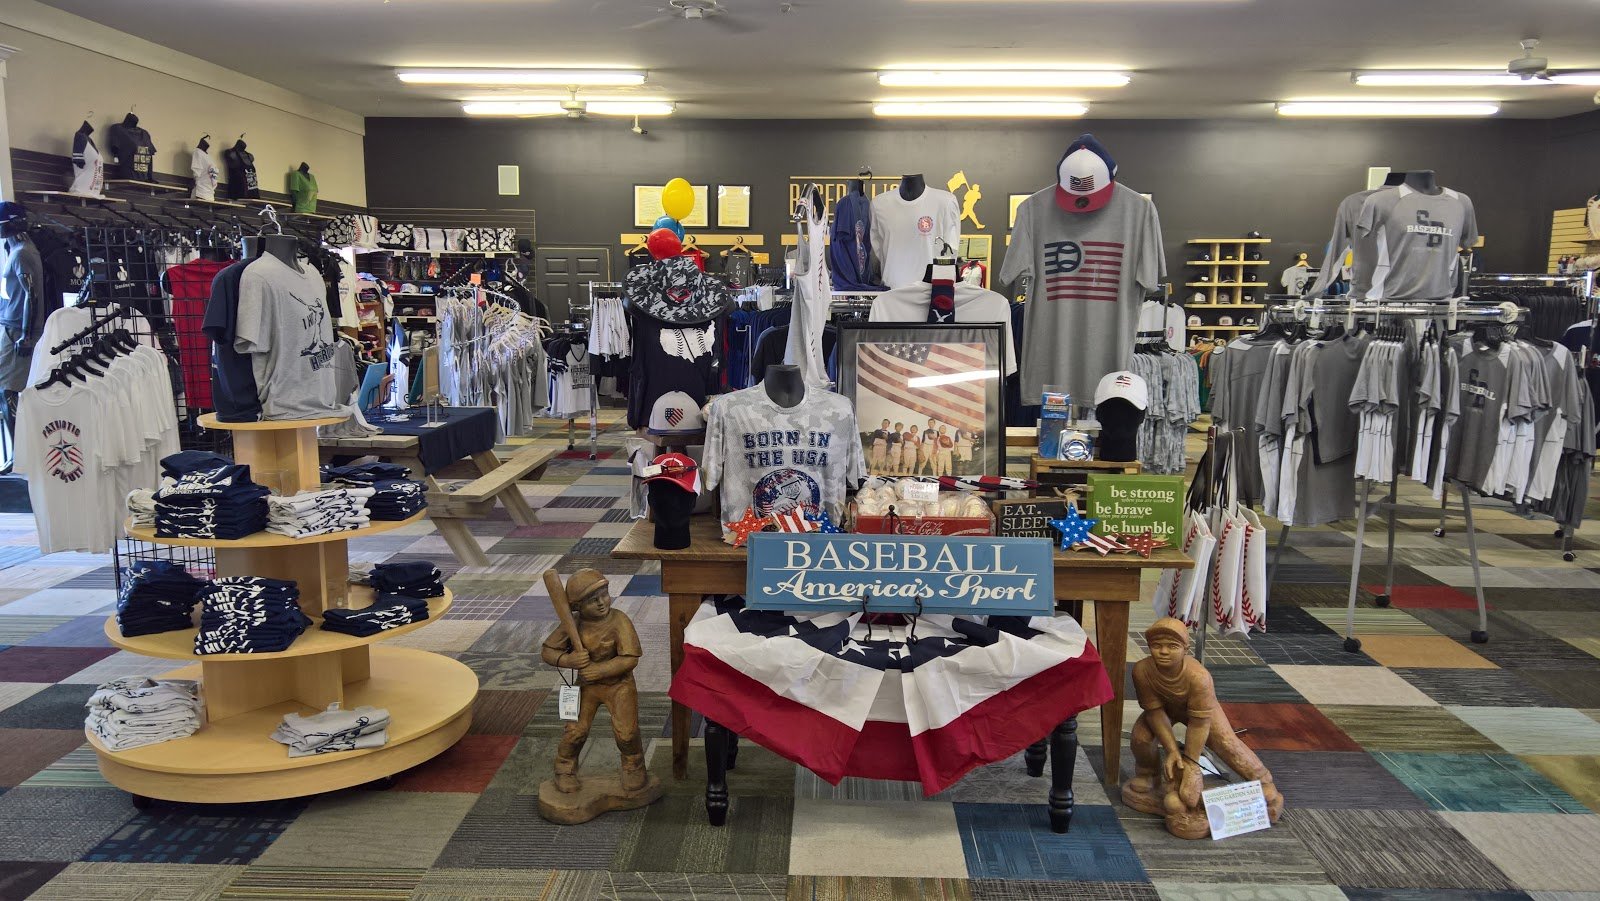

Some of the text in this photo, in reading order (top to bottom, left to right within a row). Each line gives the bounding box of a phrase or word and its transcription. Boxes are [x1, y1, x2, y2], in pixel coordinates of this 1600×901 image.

[1406, 225, 1453, 236] BASEBALL
[42, 419, 81, 439] PATRIOTIC
[743, 430, 832, 449] BORN IN
[744, 449, 829, 469] THE USA
[1110, 485, 1176, 503] be strong
[1003, 504, 1042, 516] EAT.
[1095, 502, 1153, 516] be brave
[1002, 516, 1054, 531] SLEEP
[1102, 520, 1175, 535] be humble
[783, 540, 1017, 573] BASEBALL
[762, 570, 1037, 605] America's Sport
